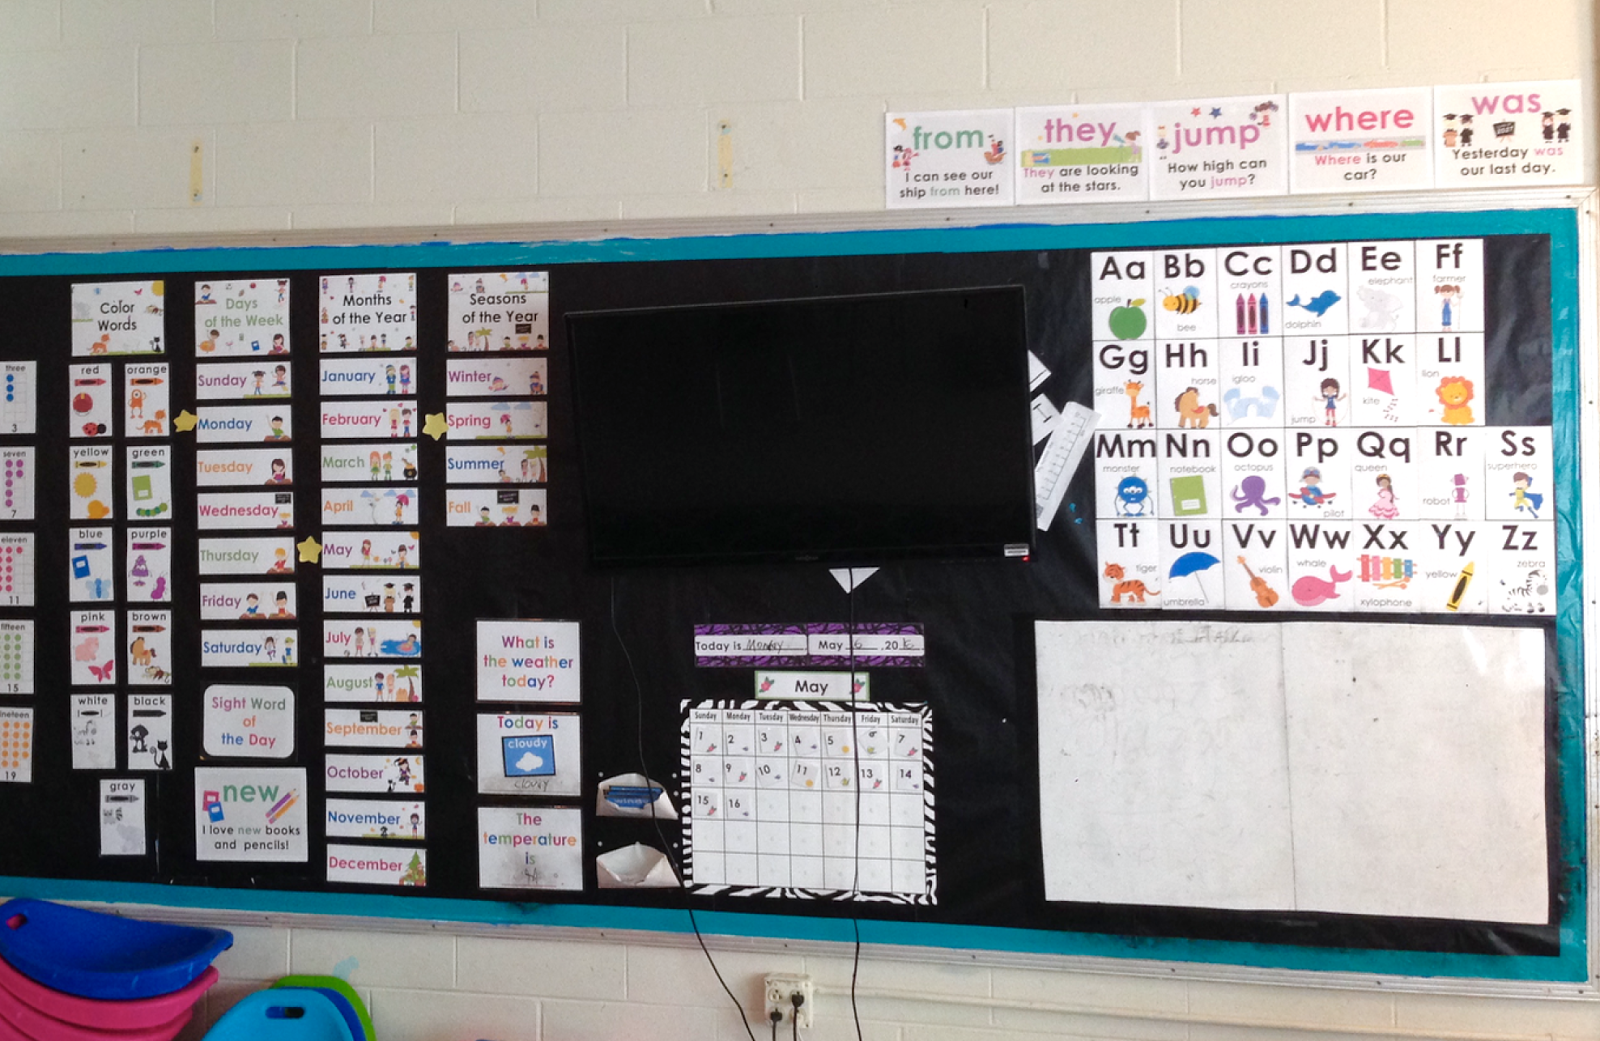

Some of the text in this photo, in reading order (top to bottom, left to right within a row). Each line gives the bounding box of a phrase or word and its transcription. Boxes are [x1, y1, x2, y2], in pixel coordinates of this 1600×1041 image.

[1471, 93, 1542, 115] was
[1305, 106, 1414, 132] where
[913, 126, 984, 150] from
[1044, 118, 1117, 147] they
[1171, 122, 1260, 154] jump
[1314, 152, 1407, 166] Where is our
[1452, 146, 1564, 160] Yesterday was
[1023, 164, 1139, 179] They are looking
[1168, 159, 1267, 174] How high can
[1460, 162, 1556, 176] our last day.
[914, 170, 993, 183] can see our
[1343, 169, 1378, 181] car?
[1041, 181, 1121, 193] at the stars.
[1180, 174, 1256, 191] you jump?
[900, 185, 999, 199] ship from here!
[1291, 248, 1337, 274] Dd
[1361, 246, 1402, 271] Ee
[1436, 243, 1463, 269] Ff
[1099, 256, 1146, 280] Aa
[1164, 253, 1205, 279] Bb
[1224, 251, 1273, 276] Cc
[1230, 280, 1268, 289] crayons
[225, 298, 258, 311] Days
[342, 294, 392, 306] Months
[469, 294, 527, 305] Seasons
[100, 301, 135, 315] Color
[98, 316, 137, 332] Words
[204, 314, 284, 328] of the Week
[332, 312, 407, 325] of the Year
[462, 310, 538, 324] of the Year
[1166, 343, 1208, 368] Hh
[1302, 339, 1328, 371] Jj
[1362, 338, 1405, 364] Kk
[1100, 344, 1149, 375] Gg
[81, 365, 99, 375] red
[126, 365, 167, 376] orange
[448, 370, 492, 383] Winter
[198, 374, 247, 389] Sunday
[321, 370, 376, 385] January
[198, 417, 253, 432] Monday
[322, 414, 381, 427] February
[448, 414, 491, 429] Spring
[1291, 415, 1316, 425] jump
[1096, 433, 1157, 458] Mm
[1166, 433, 1210, 458] Nn
[1227, 432, 1278, 457] Oo
[1297, 432, 1339, 463] Pp
[1357, 431, 1410, 463] Qq
[1435, 431, 1467, 457] Rr
[1500, 430, 1536, 457] Ss
[73, 447, 109, 458] yellow
[132, 448, 165, 460] green
[198, 460, 253, 475] Tuesday
[323, 456, 364, 468] March
[447, 458, 505, 470] Summer
[1103, 465, 1140, 473] monster
[1170, 465, 1216, 473] notebook
[1234, 464, 1273, 472] octopus
[1355, 464, 1387, 472] queen
[1487, 462, 1538, 471] superhero
[199, 504, 279, 518] Wednesday
[323, 500, 353, 515] April
[449, 501, 471, 513] Fall
[79, 529, 103, 539] blue
[131, 529, 167, 541] purple
[1113, 522, 1140, 548] Tt
[1170, 523, 1210, 549] Uu
[1232, 524, 1276, 549] Vv
[1290, 524, 1351, 549] Ww
[1362, 524, 1408, 550] Xx
[1431, 524, 1476, 557] Yy
[1502, 525, 1538, 551] Zz
[200, 549, 259, 564] Thursday
[323, 544, 352, 556] May
[1425, 570, 1458, 579] yellow
[324, 588, 357, 600] June
[202, 595, 241, 610] Friday
[1163, 598, 1205, 606] umbrella
[1360, 598, 1412, 607] xylophone
[81, 612, 105, 623] pink
[132, 612, 166, 622] brown
[325, 631, 351, 646] July
[501, 636, 555, 649] What is
[203, 641, 262, 656] Saturday
[695, 641, 742, 652] Today is
[818, 641, 843, 651] May
[483, 655, 573, 669] the weather
[326, 676, 373, 692] August
[501, 674, 555, 691] today?
[795, 680, 829, 695] May
[78, 696, 108, 705] white
[133, 696, 165, 706] black
[212, 697, 286, 712] Sight Word
[243, 715, 257, 728] of
[497, 716, 559, 732] Today is
[694, 712, 717, 721] Sunday
[726, 713, 751, 721] Monday
[758, 713, 784, 722] Tuesday
[789, 714, 819, 722] Wednesday
[861, 715, 881, 724] Friday
[891, 716, 919, 725] Saturday
[326, 721, 402, 738] September
[221, 733, 276, 749] the Day
[508, 737, 548, 750] cloudy
[327, 766, 384, 780] October
[109, 783, 136, 792] gray
[223, 784, 279, 802] new
[328, 811, 400, 825] November
[516, 812, 542, 825] The
[209, 825, 300, 835] love new books
[214, 840, 289, 852] and pencils!
[483, 832, 577, 847] temperature
[328, 856, 403, 871] December
[525, 852, 536, 865] is
